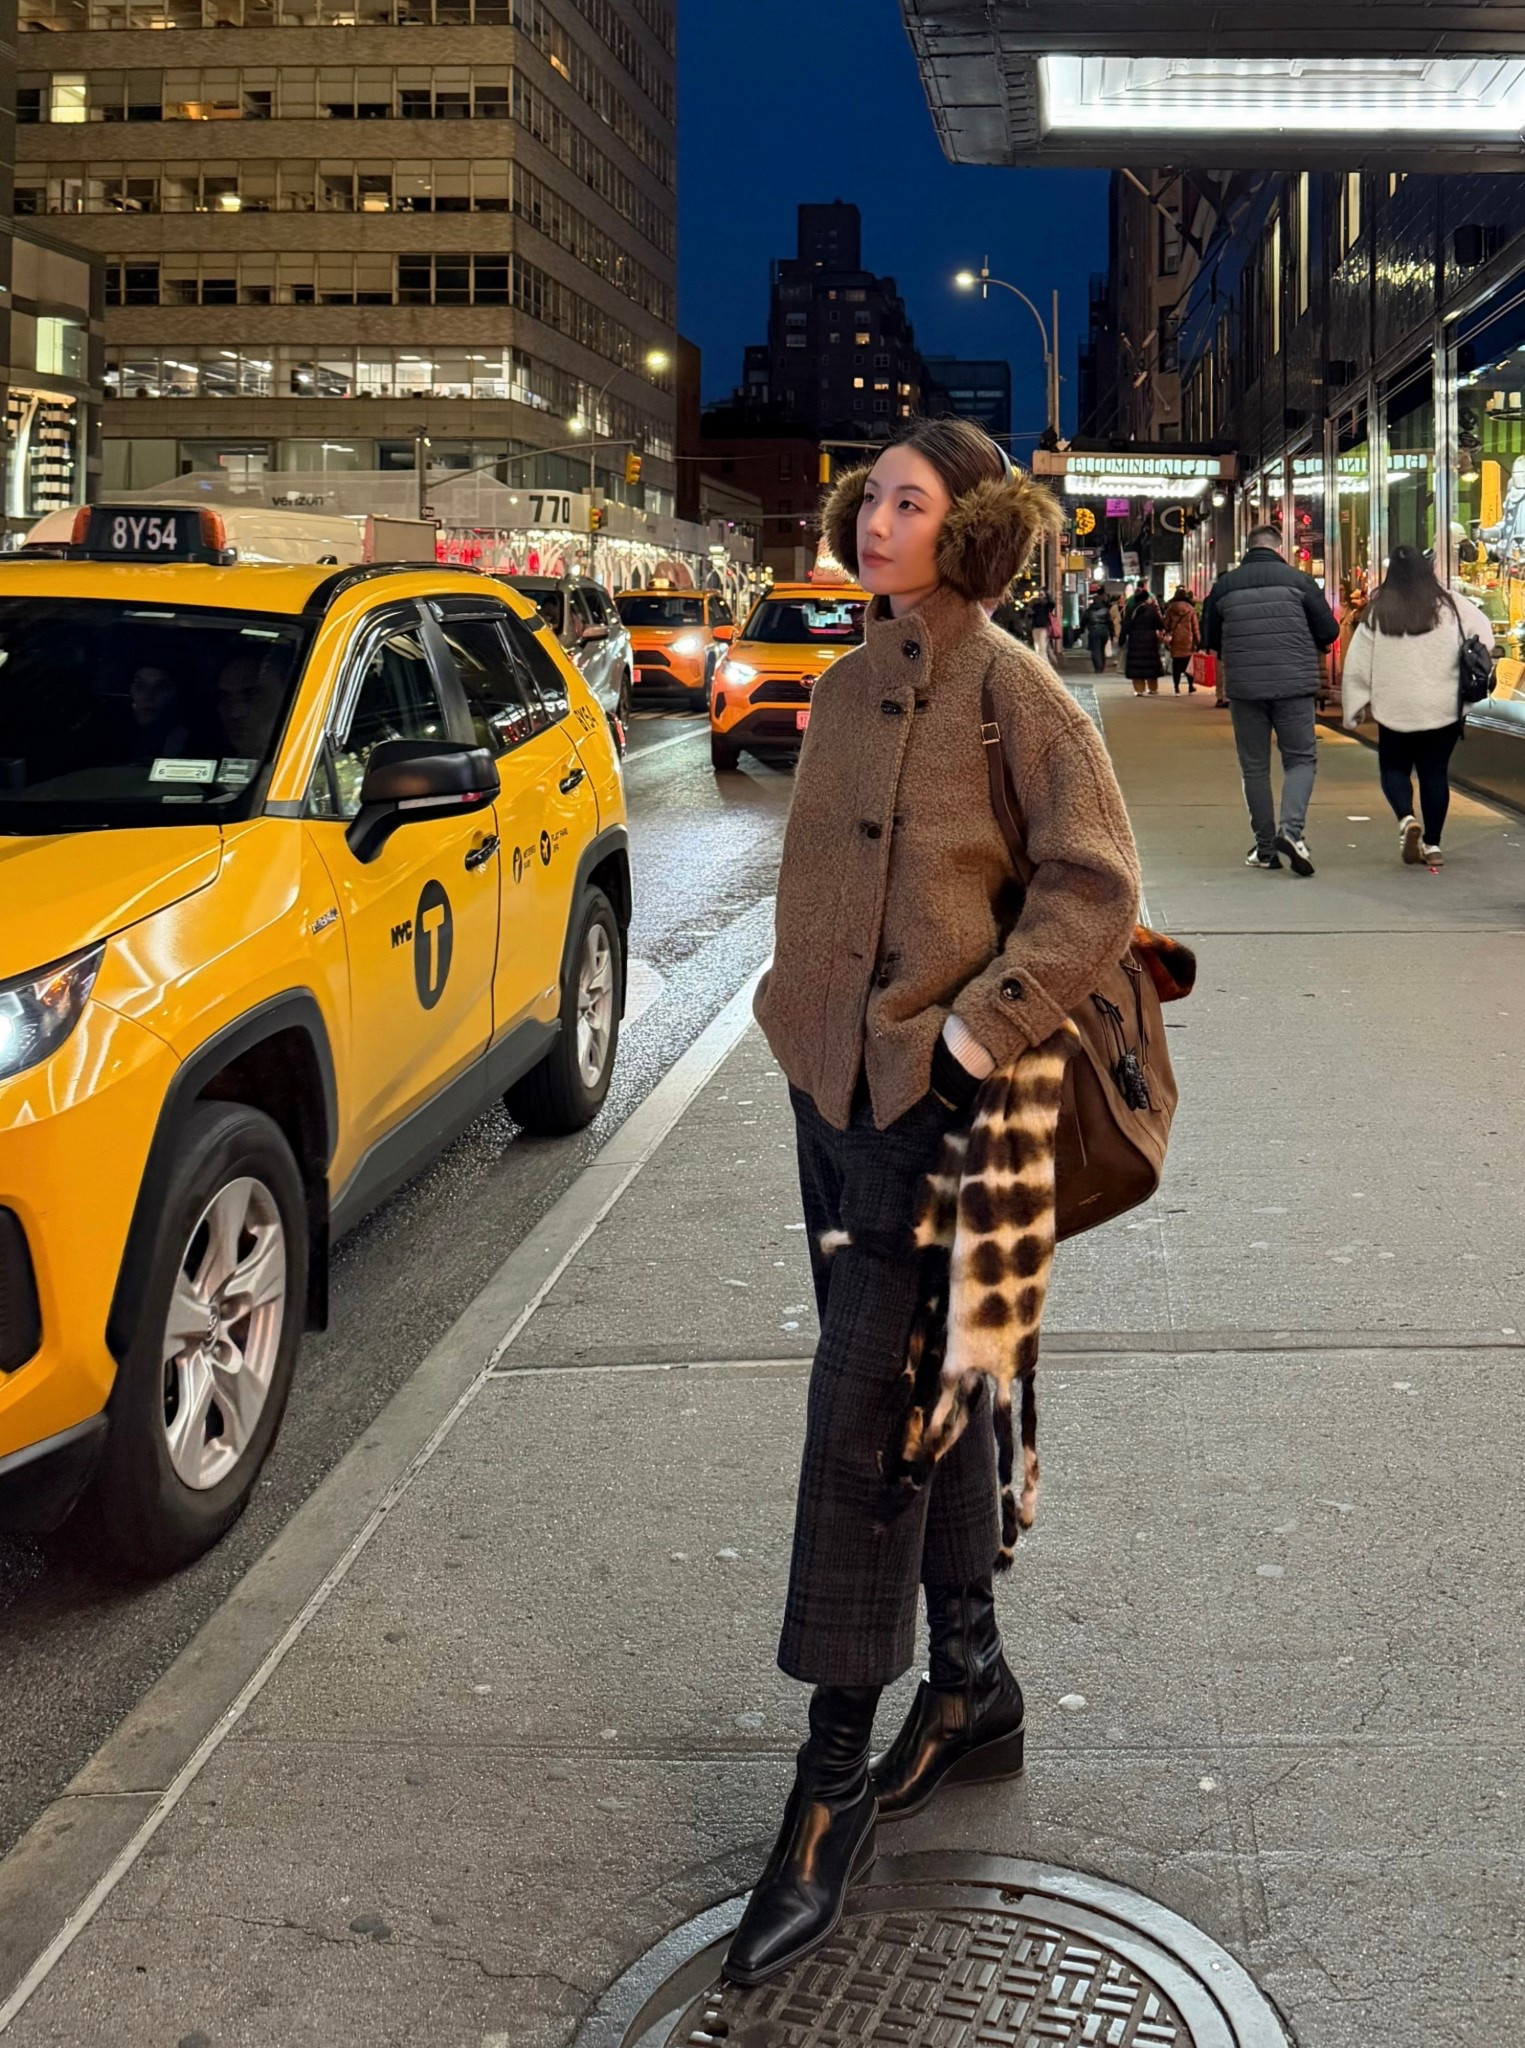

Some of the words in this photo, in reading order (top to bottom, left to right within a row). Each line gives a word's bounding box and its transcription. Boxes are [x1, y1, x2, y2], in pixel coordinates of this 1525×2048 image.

[272, 495, 324, 506] verizon
[529, 495, 570, 524] 770
[113, 516, 177, 550] 8Y54
[574, 705, 599, 731] 8Y54
[390, 919, 413, 949] NYC
